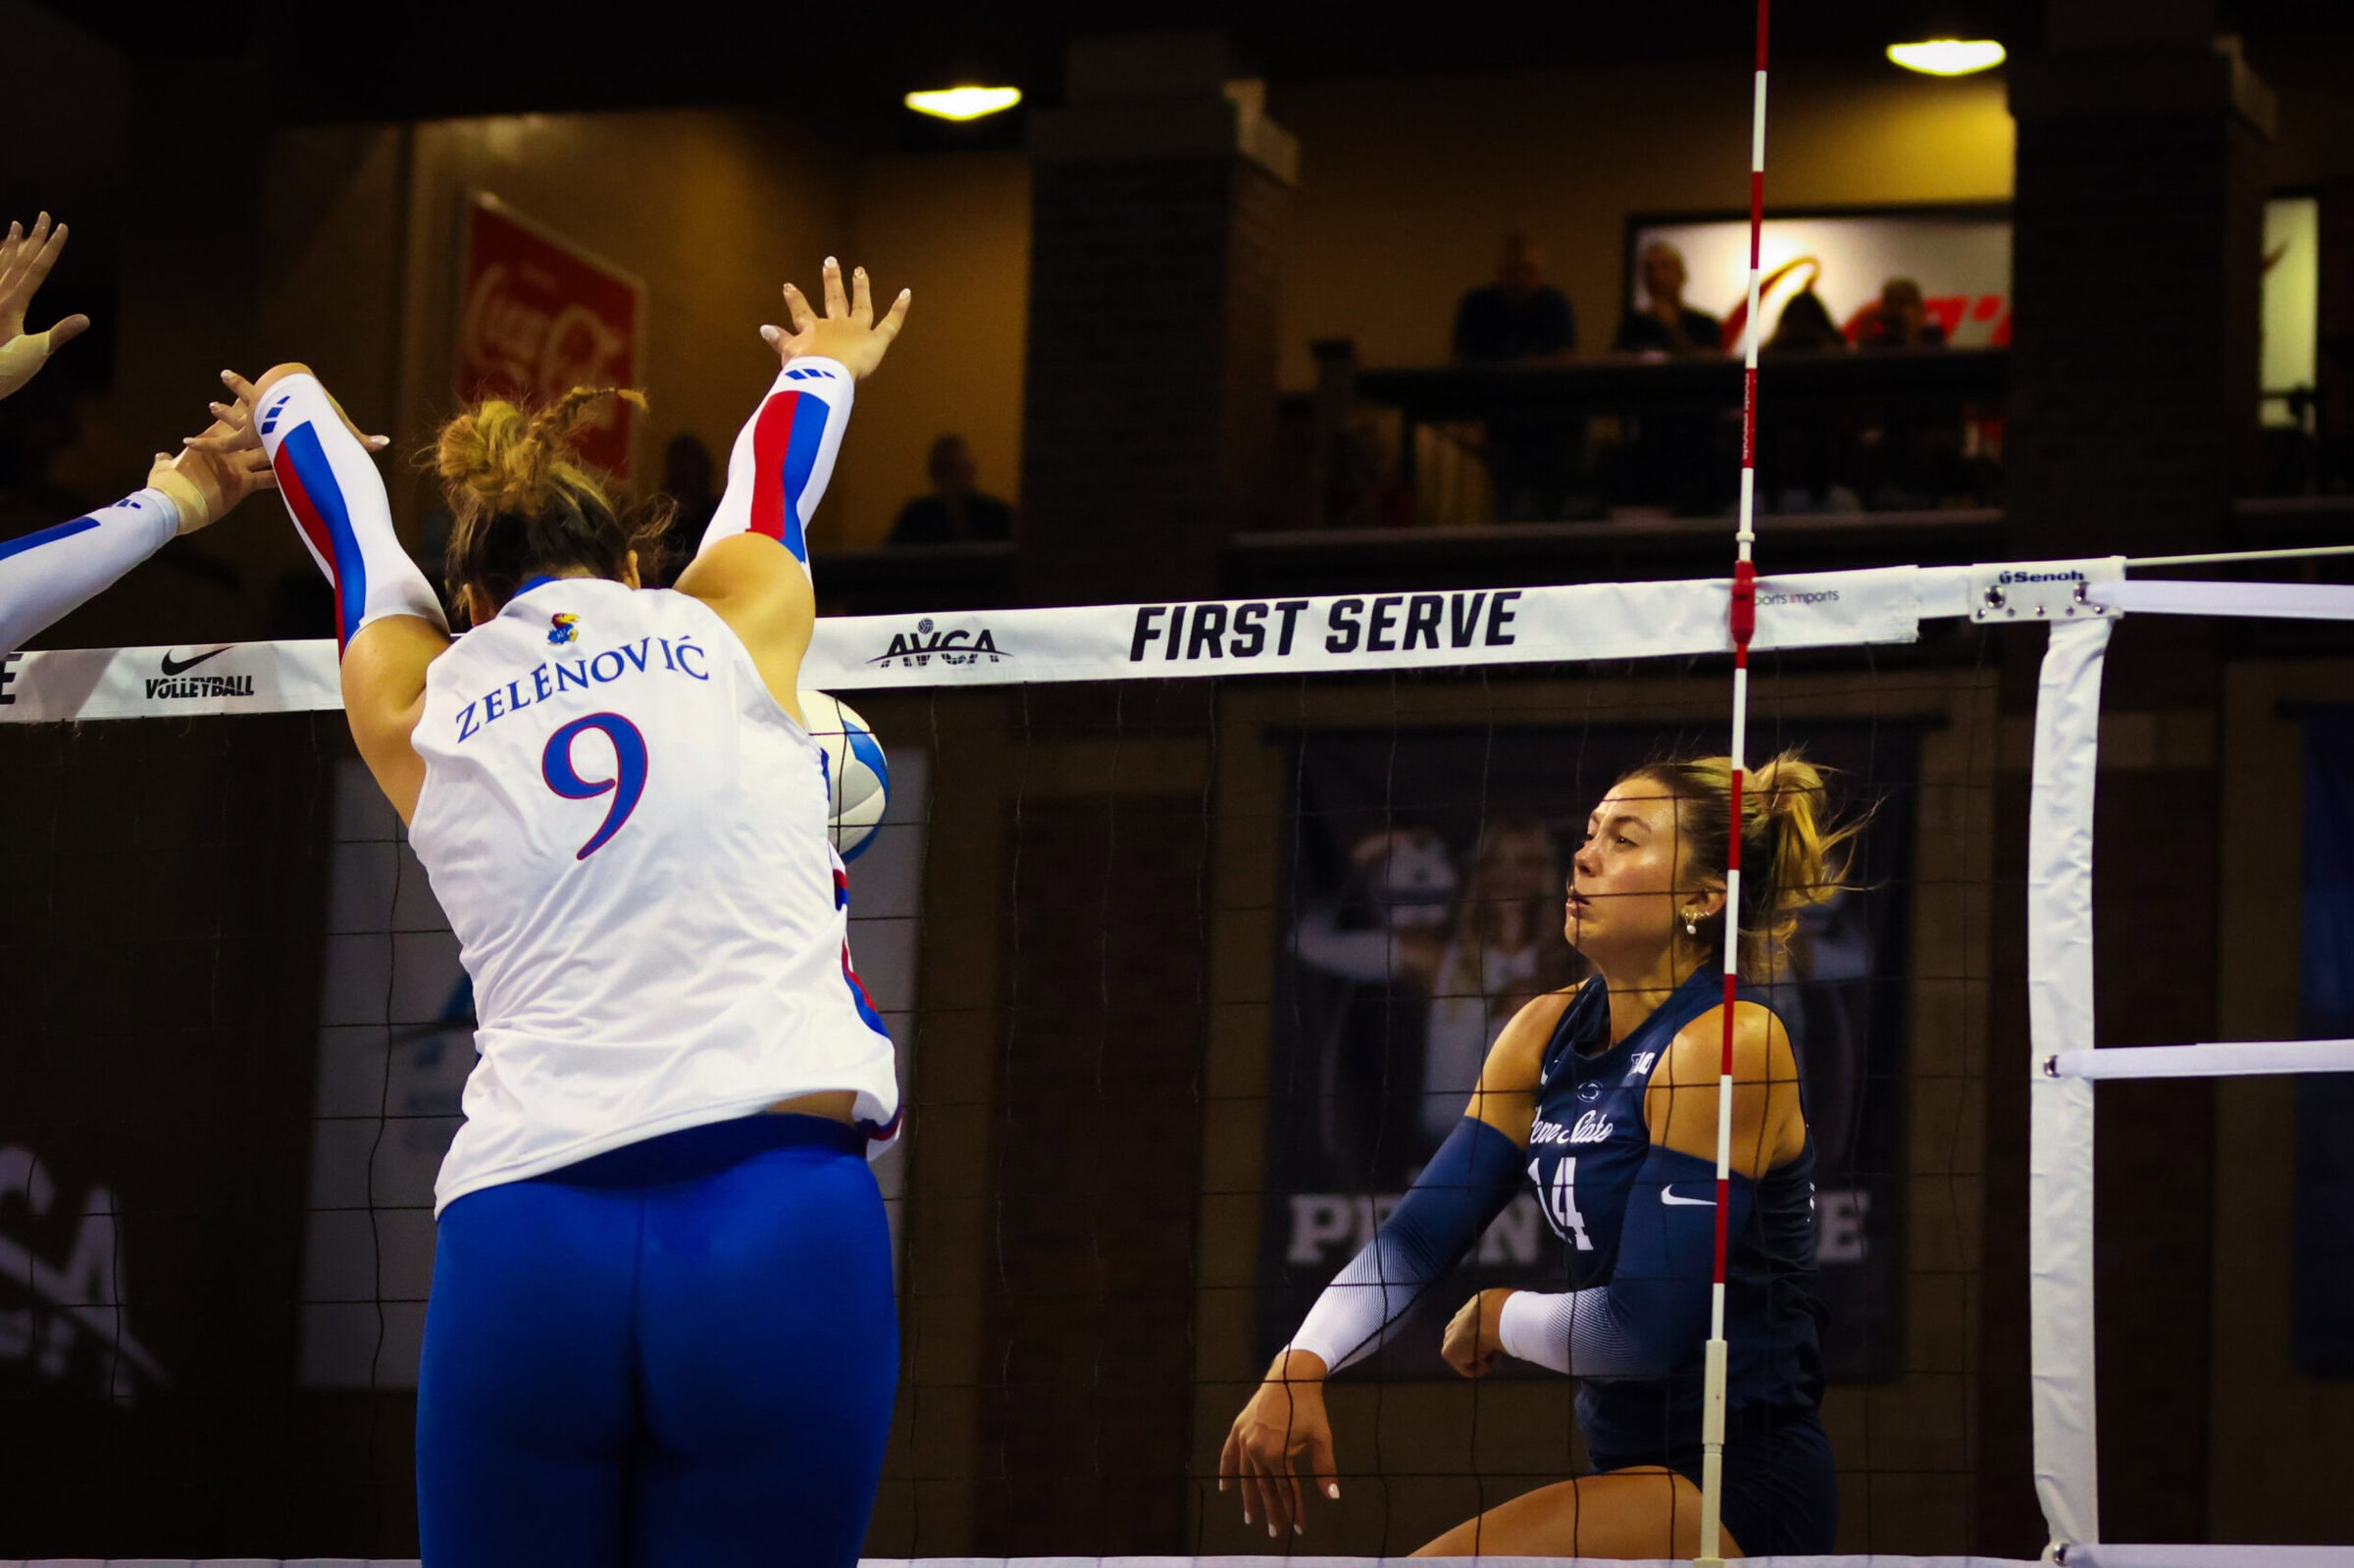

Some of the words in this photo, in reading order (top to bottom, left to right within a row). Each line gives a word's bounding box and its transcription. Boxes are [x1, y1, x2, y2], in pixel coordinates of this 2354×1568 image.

[1755, 592, 1788, 606] ports
[2014, 570, 2084, 583] Senoh
[880, 630, 999, 668] AVCA
[1130, 601, 1309, 661] FIRST
[1325, 591, 1522, 653] SERVE
[145, 675, 254, 699] VOLLEYBALL
[455, 635, 709, 744] ZELENOVIĆ
[542, 712, 648, 861] 9
[1527, 1156, 1594, 1251] 14
